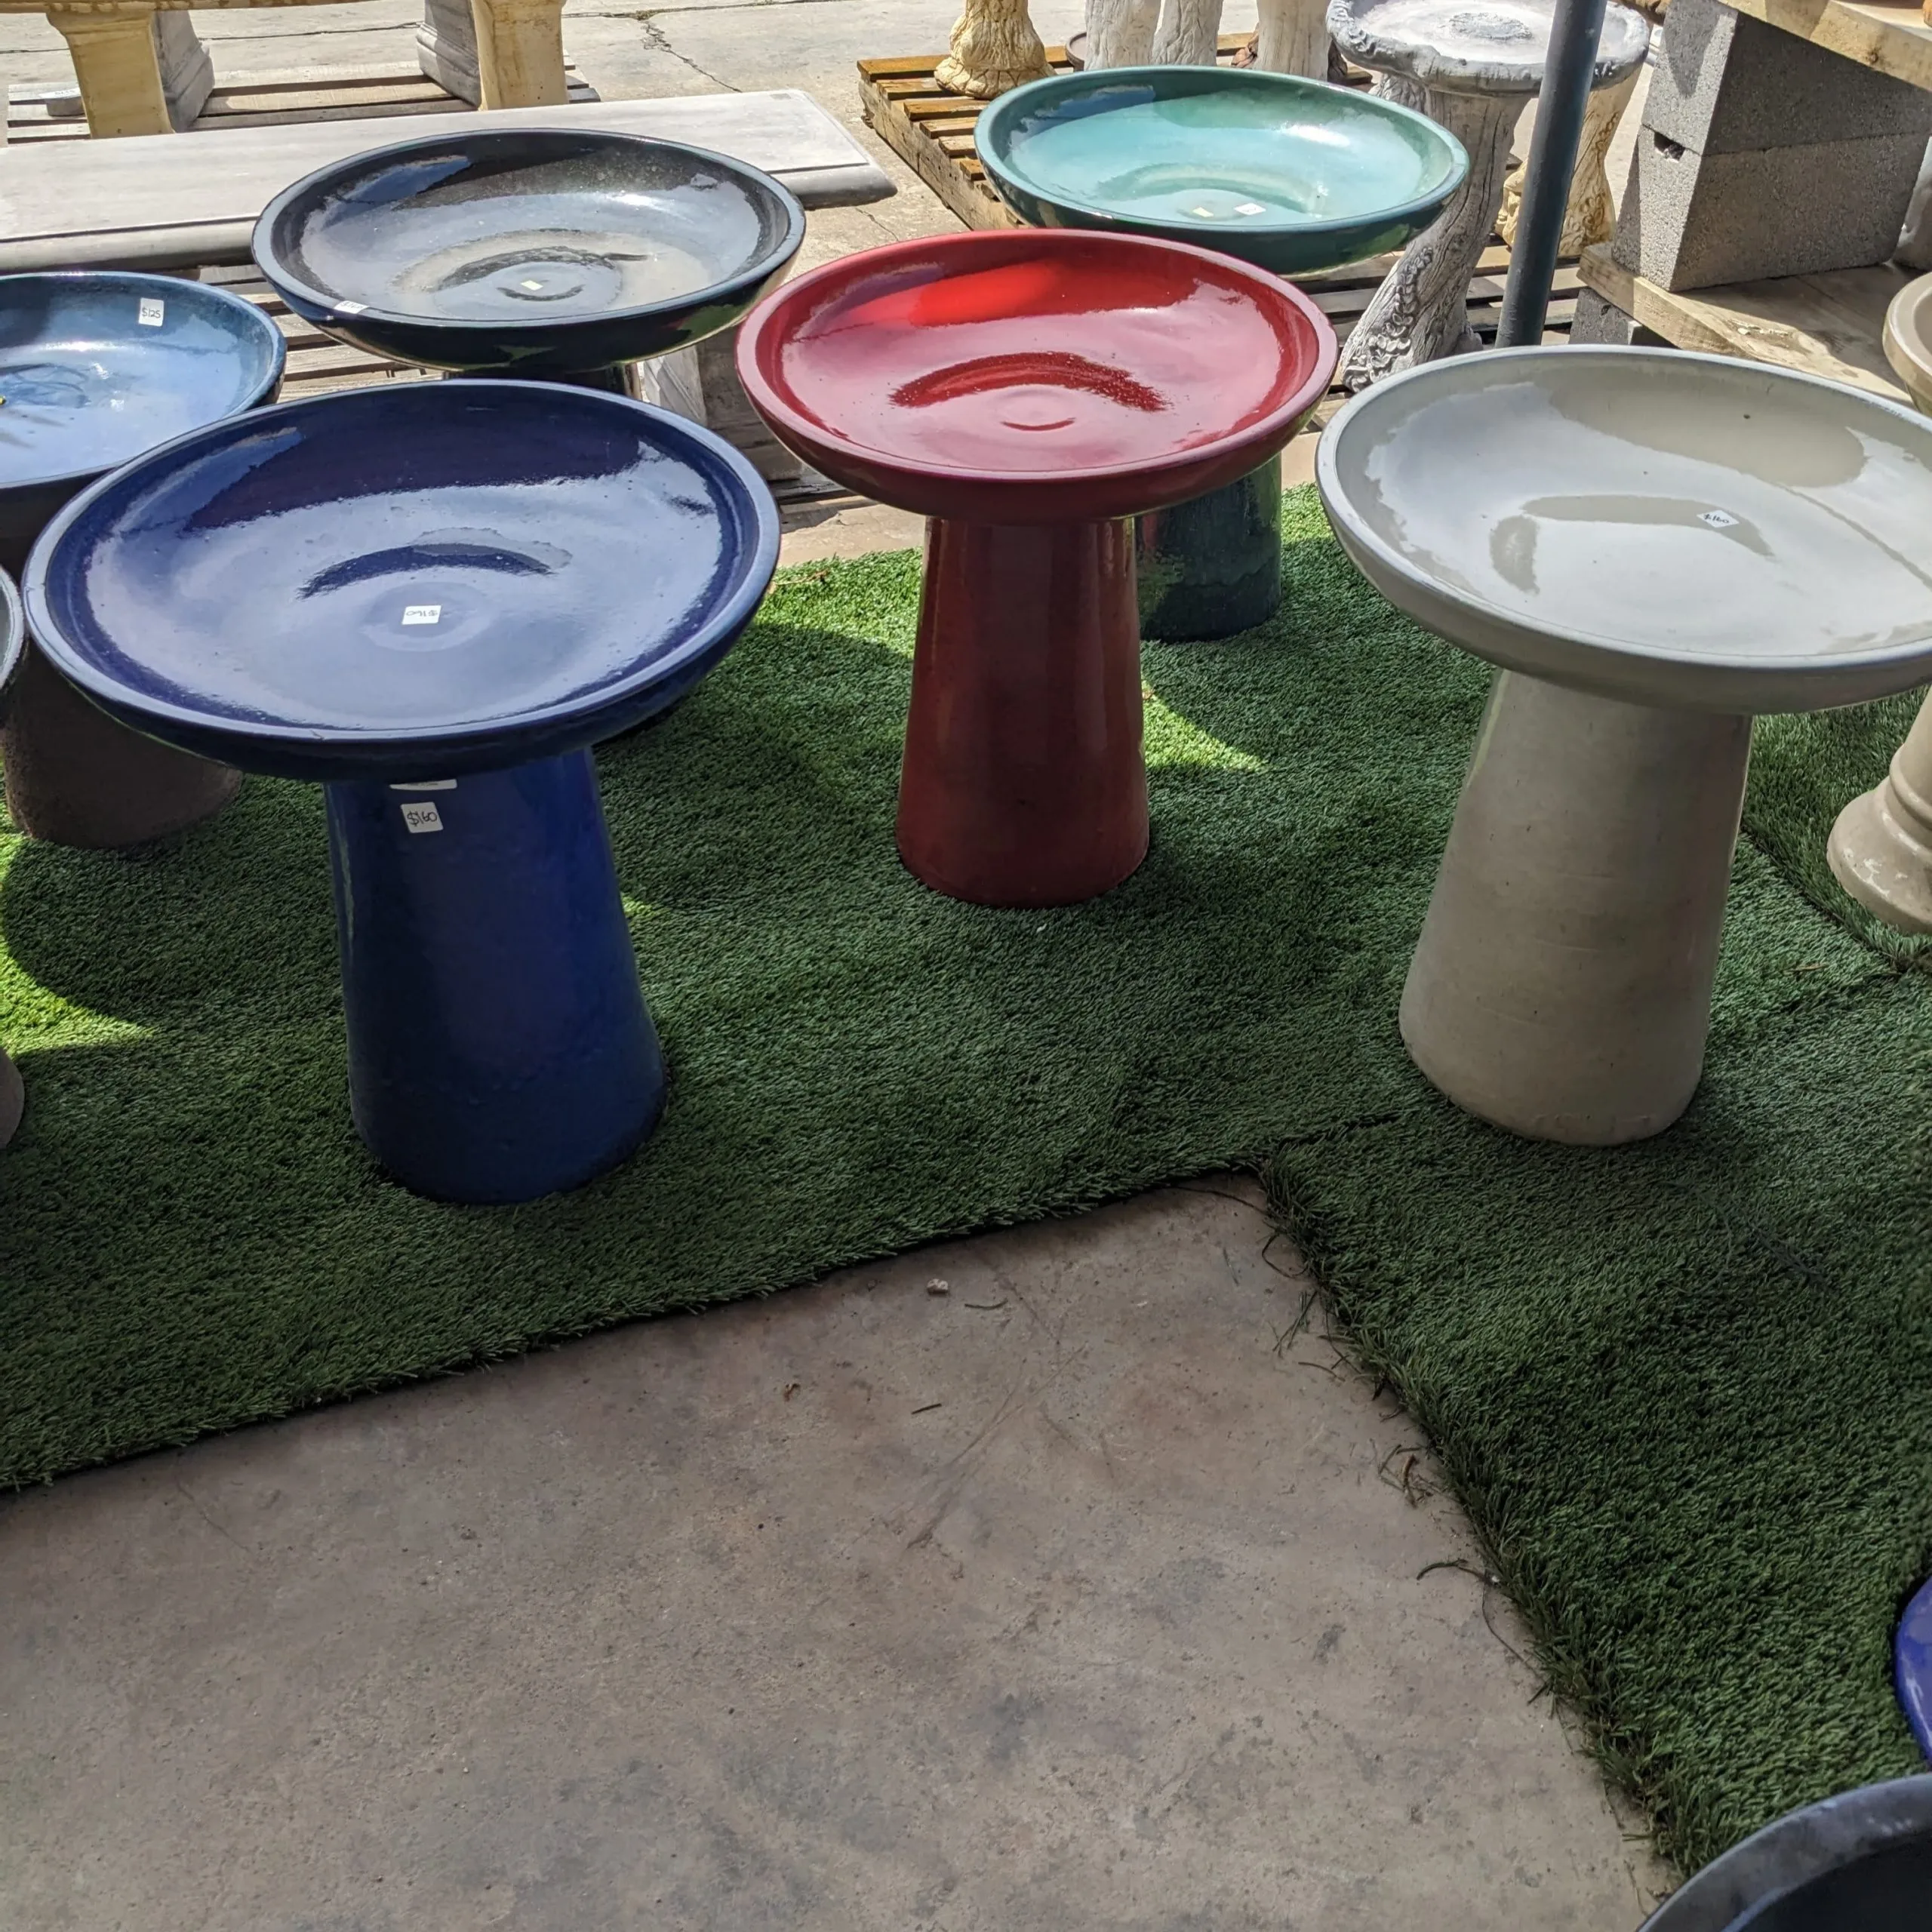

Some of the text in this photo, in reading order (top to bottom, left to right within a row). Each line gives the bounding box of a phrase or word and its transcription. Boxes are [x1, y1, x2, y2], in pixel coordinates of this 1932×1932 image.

[142, 306, 161, 318] $125
[1703, 513, 1730, 523] $160
[407, 811, 438, 827] $160
